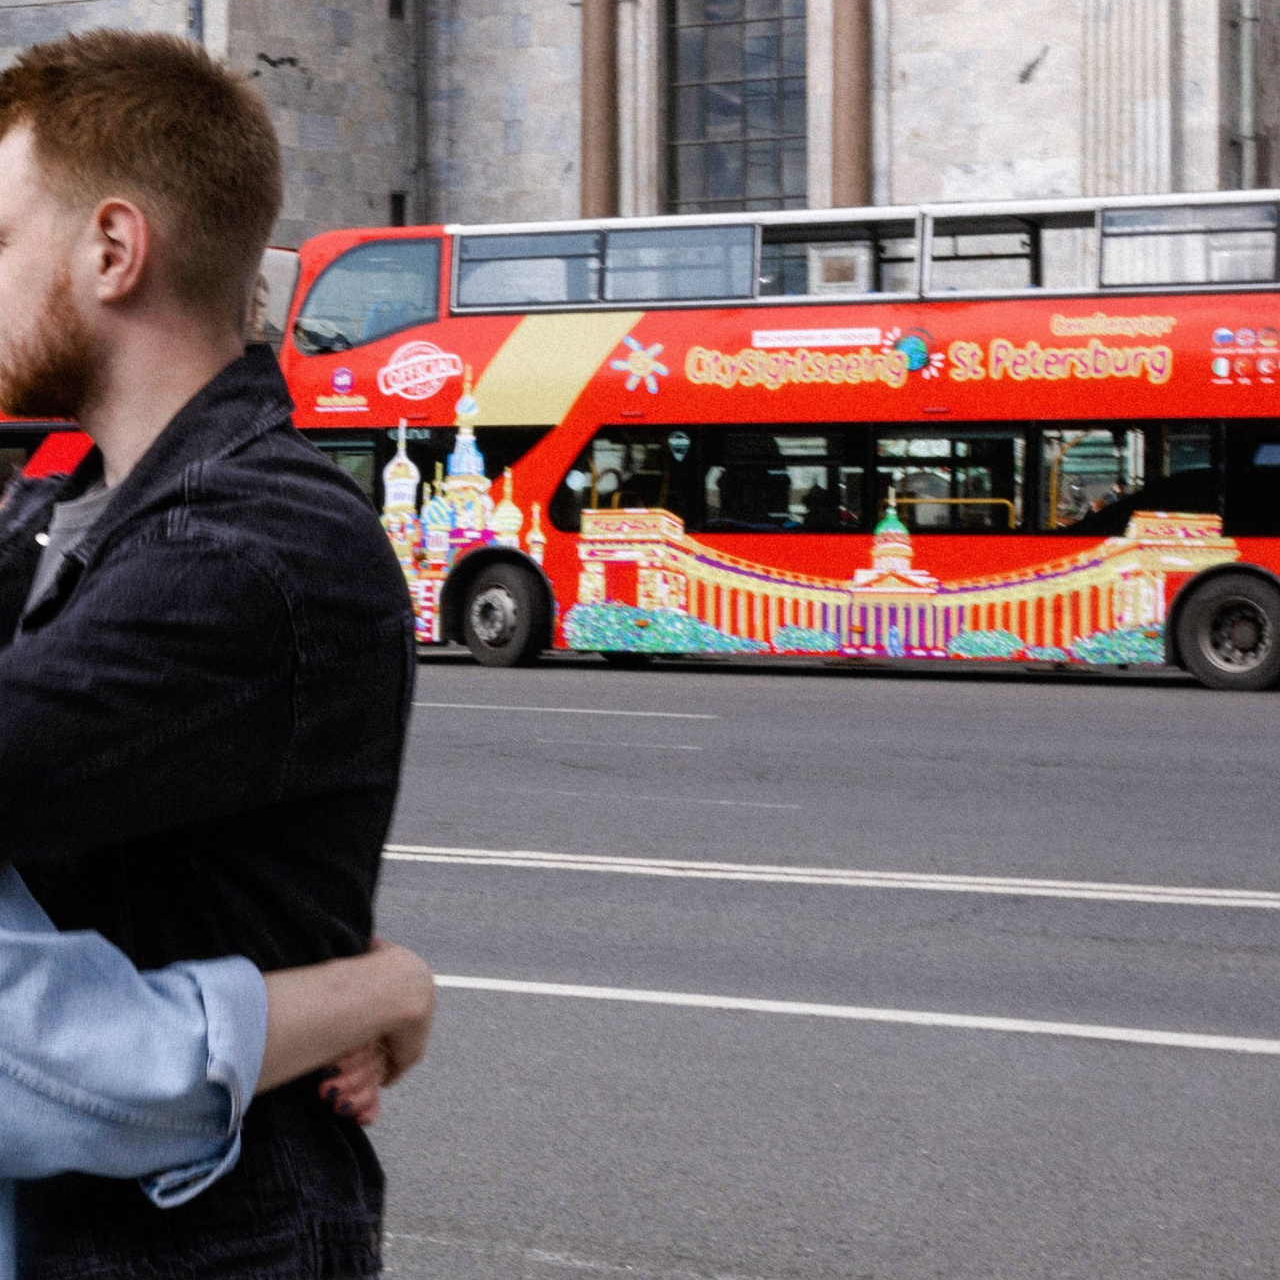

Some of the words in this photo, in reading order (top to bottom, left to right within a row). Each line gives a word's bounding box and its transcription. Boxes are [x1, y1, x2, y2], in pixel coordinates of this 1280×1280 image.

[686, 345, 908, 388] CitySightseeing
[949, 340, 984, 381] St
[989, 339, 1173, 384] Petersburg
